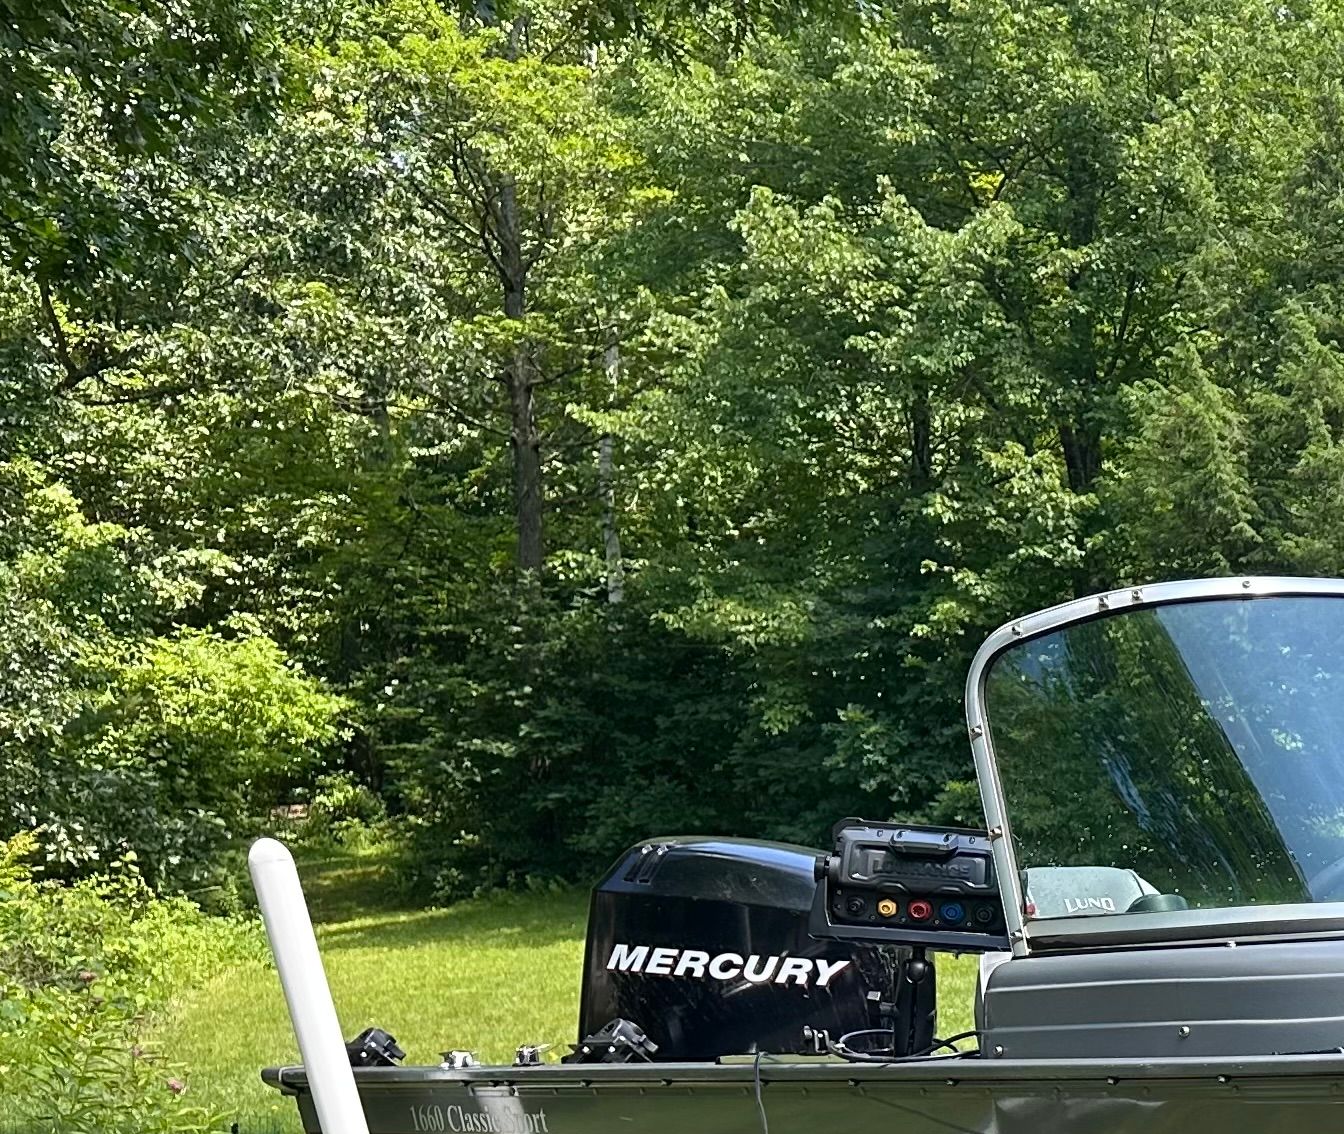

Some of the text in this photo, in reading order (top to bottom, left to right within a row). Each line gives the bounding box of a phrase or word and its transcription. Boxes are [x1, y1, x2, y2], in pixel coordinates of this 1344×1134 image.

[1064, 897, 1117, 913] LUND
[606, 943, 851, 987] MERCURY
[409, 1105, 445, 1132] 1660
[447, 1104, 502, 1133] Classic
